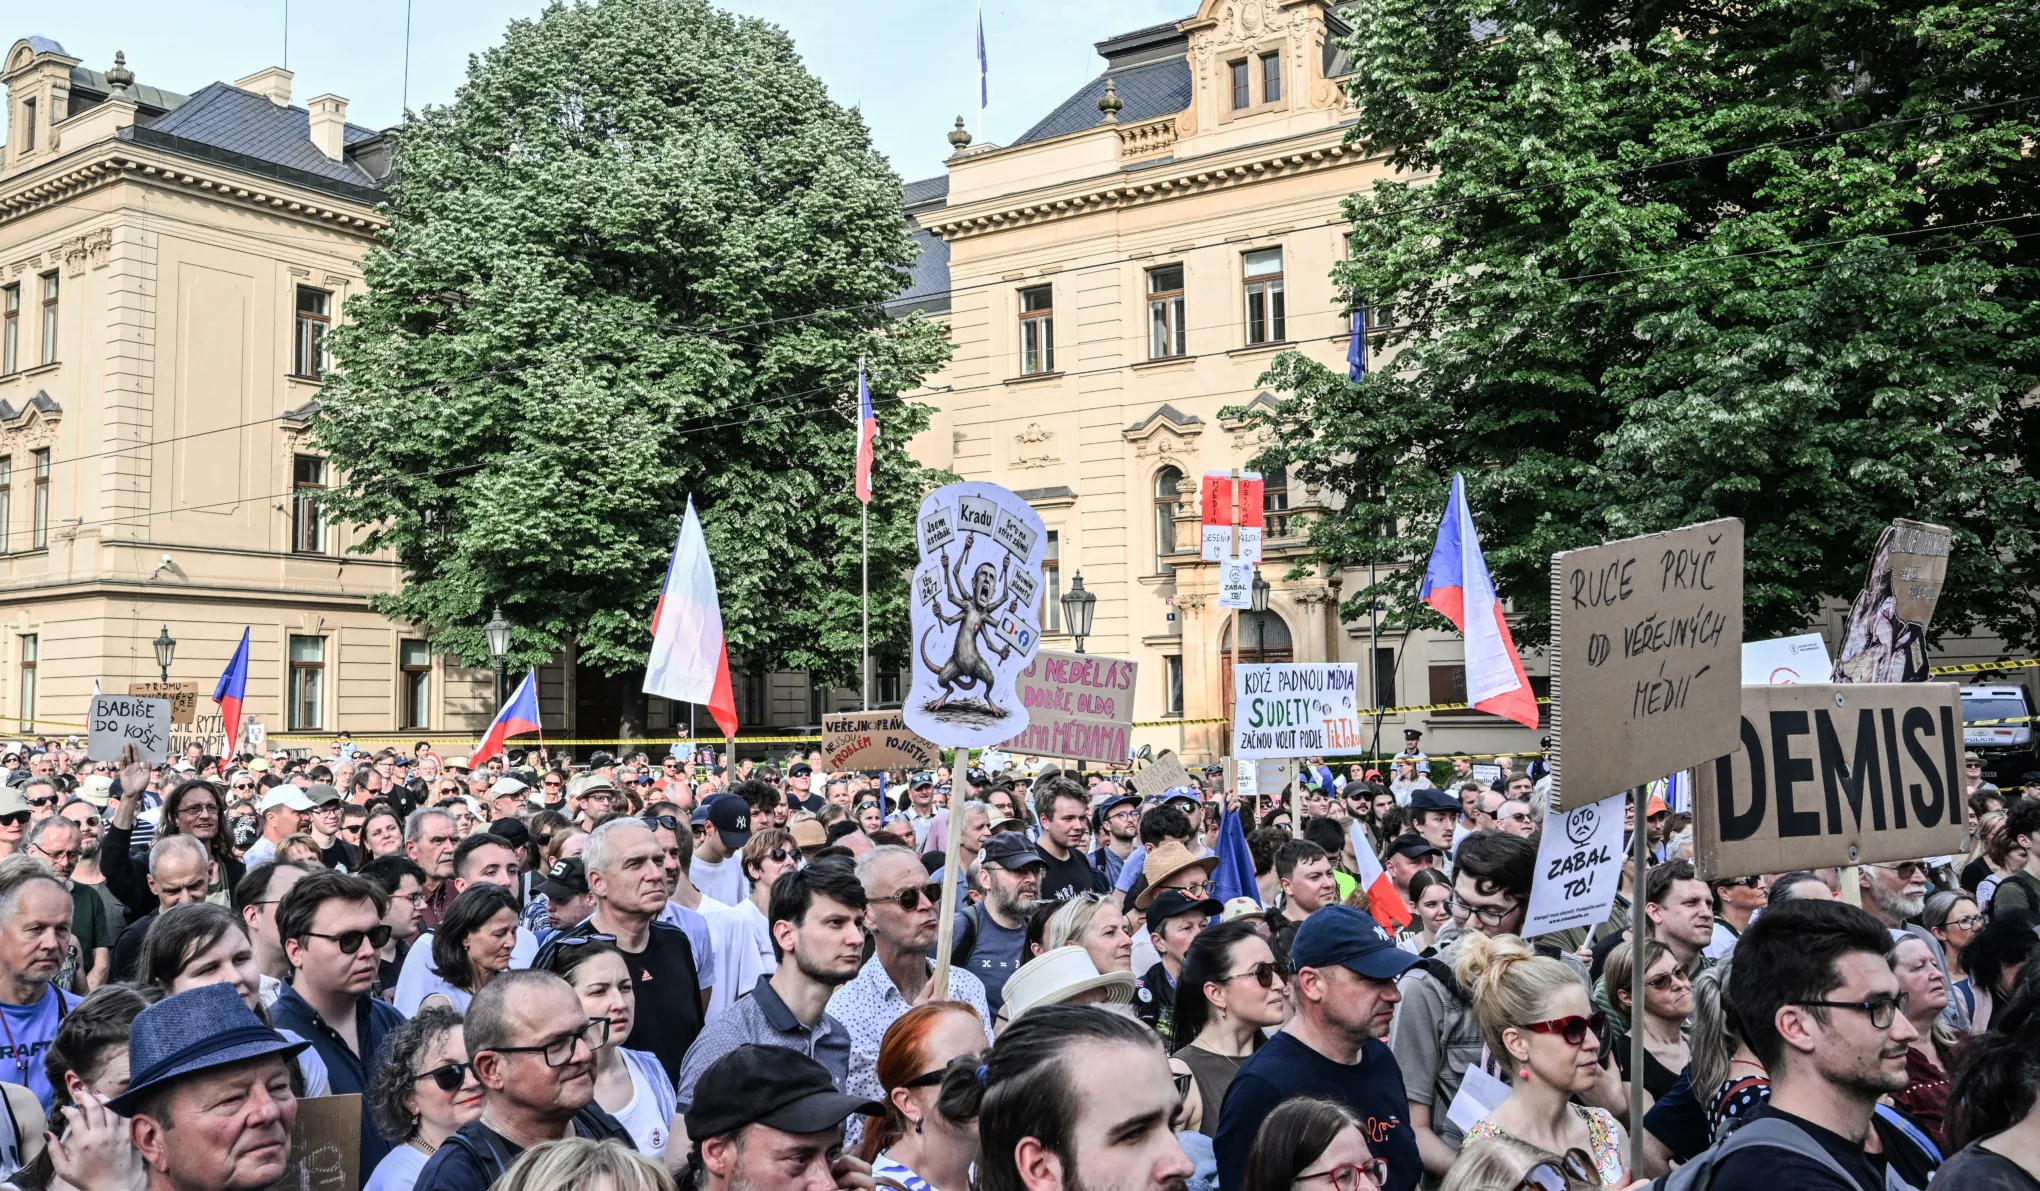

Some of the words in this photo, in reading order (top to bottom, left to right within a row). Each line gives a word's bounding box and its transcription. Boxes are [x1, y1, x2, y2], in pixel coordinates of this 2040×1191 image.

[927, 517, 946, 534] Jsem
[961, 503, 992, 527] Kradu
[1570, 557, 1636, 609] RUCE
[1660, 532, 1723, 592] PRYČ
[922, 581, 938, 599] 24/7
[1588, 633, 1611, 667] OD
[1624, 602, 1727, 659] VEŘEJNÝCH
[1045, 657, 1133, 690] NEDĚLÁŠ
[1245, 666, 1273, 695] KDYŽ
[1278, 669, 1323, 692] PADNOU
[1326, 664, 1355, 691] MÉDIA
[97, 698, 155, 719] BABIŠE
[1248, 697, 1310, 728] SUDETY
[94, 720, 118, 732] DO
[124, 722, 162, 752] KOŠE
[825, 733, 857, 755] NEJSOU
[885, 736, 931, 767] POJISTKA
[1052, 719, 1125, 762] MÉDIAMA
[1240, 729, 1272, 750] ZAČNOU
[1275, 729, 1296, 750] VOLIT
[1300, 729, 1323, 750] PODLE
[830, 735, 872, 769] PROBLÉM
[1715, 705, 1962, 842] DEMISI
[1572, 808, 1594, 826] OTO
[1547, 844, 1611, 880] ZABAL
[1563, 870, 1595, 900] TO!
